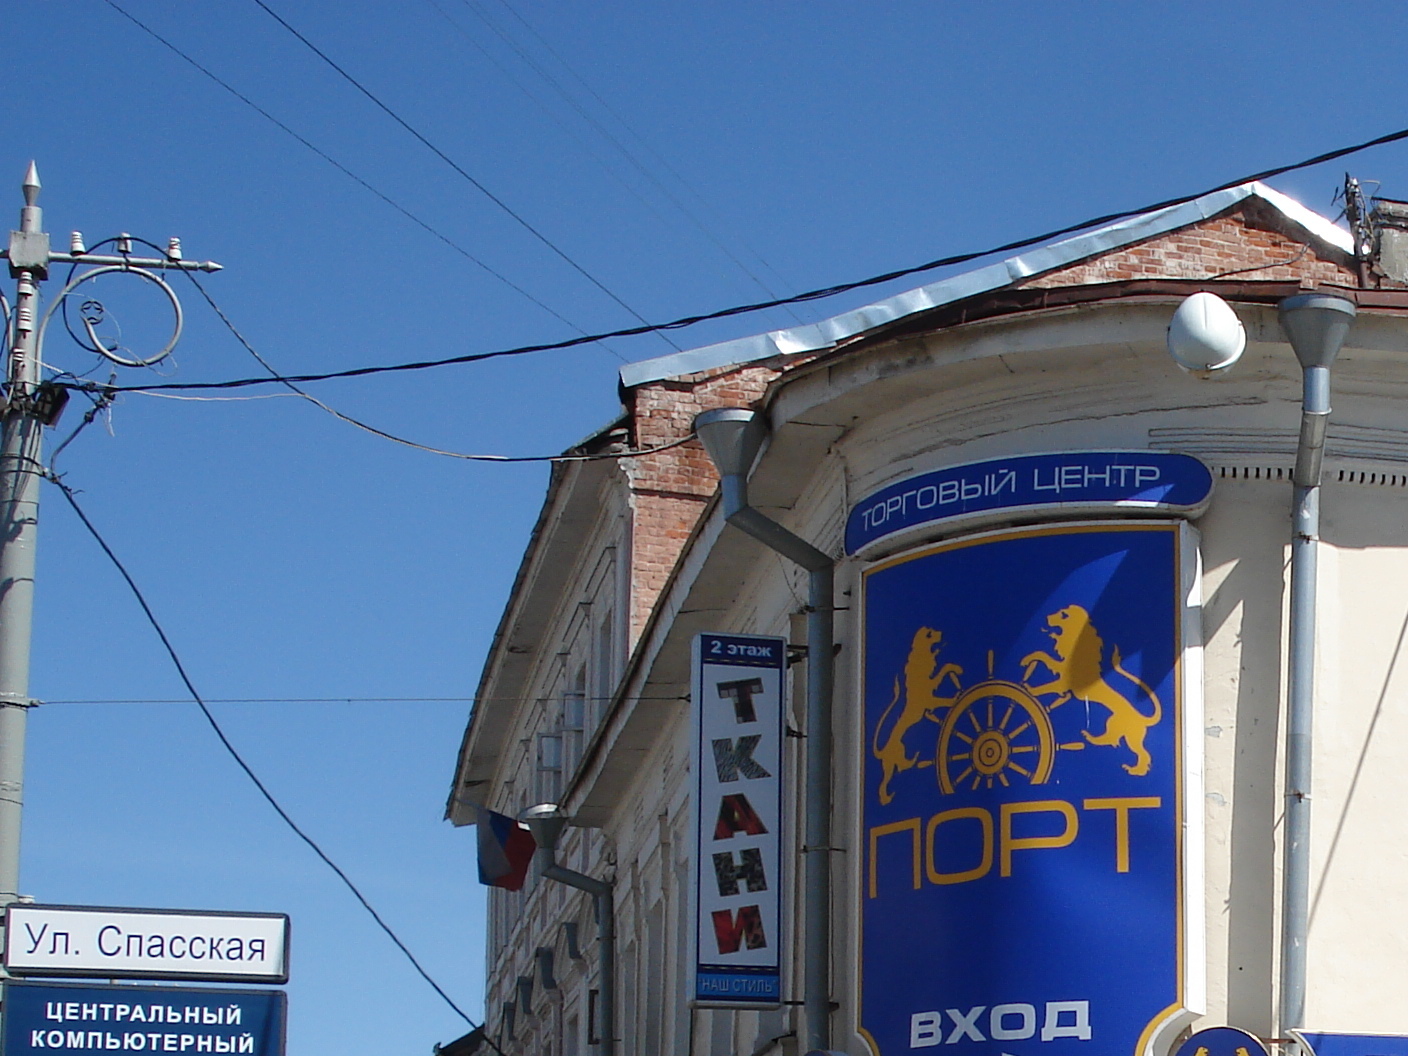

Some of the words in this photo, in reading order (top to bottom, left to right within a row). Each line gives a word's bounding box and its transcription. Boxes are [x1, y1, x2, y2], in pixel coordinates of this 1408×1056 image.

[862, 469, 1016, 532] ТОРГОВЫЙ
[1034, 465, 1161, 493] ЦЕНТР
[711, 640, 722, 654] 2
[727, 644, 772, 657] этаж
[711, 677, 772, 955] ТКАНИ
[869, 796, 1163, 899] ПОРТ
[25, 923, 80, 955] Ул.
[98, 925, 266, 962] Спасская
[46, 1002, 243, 1026] ЦЕНТРАЛЬНЫЙ
[910, 1000, 1092, 1050] ВХОД
[31, 1030, 255, 1055] КОМПЬЮТЕРНЫЙ
